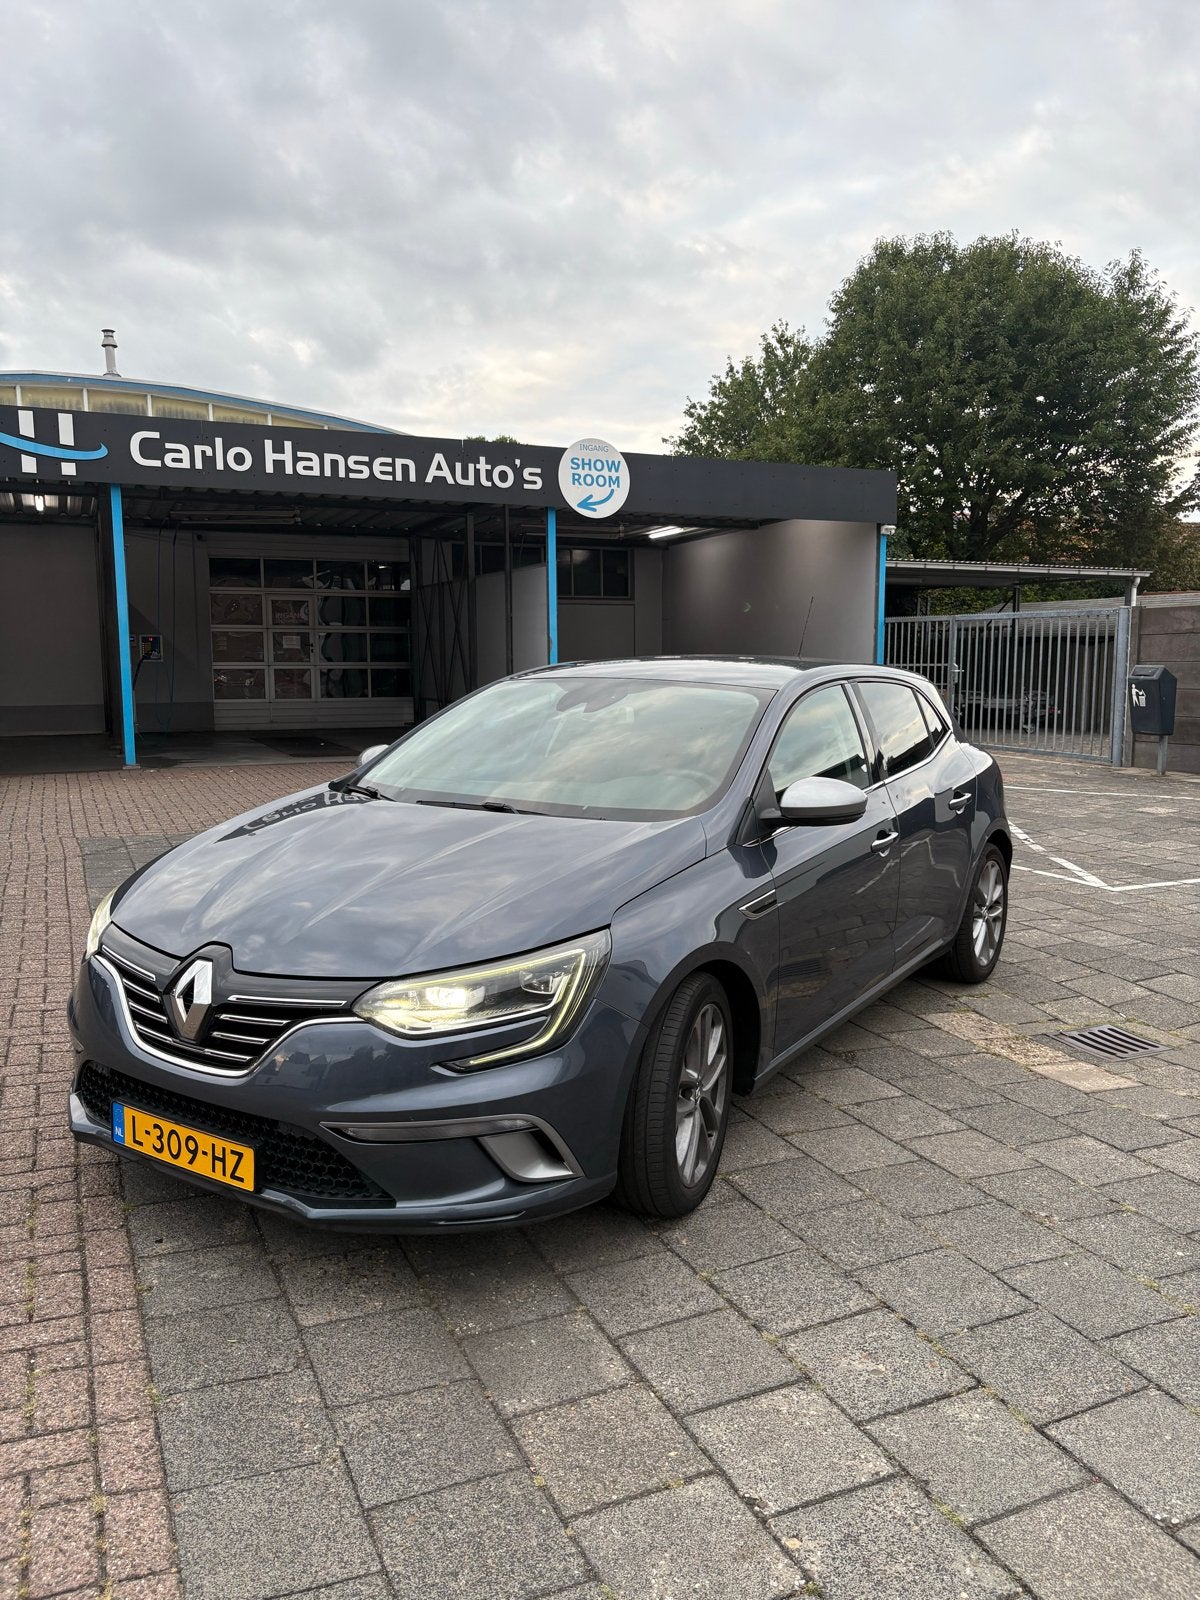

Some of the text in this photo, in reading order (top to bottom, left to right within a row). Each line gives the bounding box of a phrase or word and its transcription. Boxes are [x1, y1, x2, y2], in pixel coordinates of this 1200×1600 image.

[579, 443, 609, 452] INGANG
[129, 430, 543, 490] Carlo Hansen Auto's
[570, 457, 621, 473] SHOW
[572, 472, 621, 488] ROOM
[115, 1126, 124, 1138] NL
[131, 1115, 245, 1183] L-309-HZ
